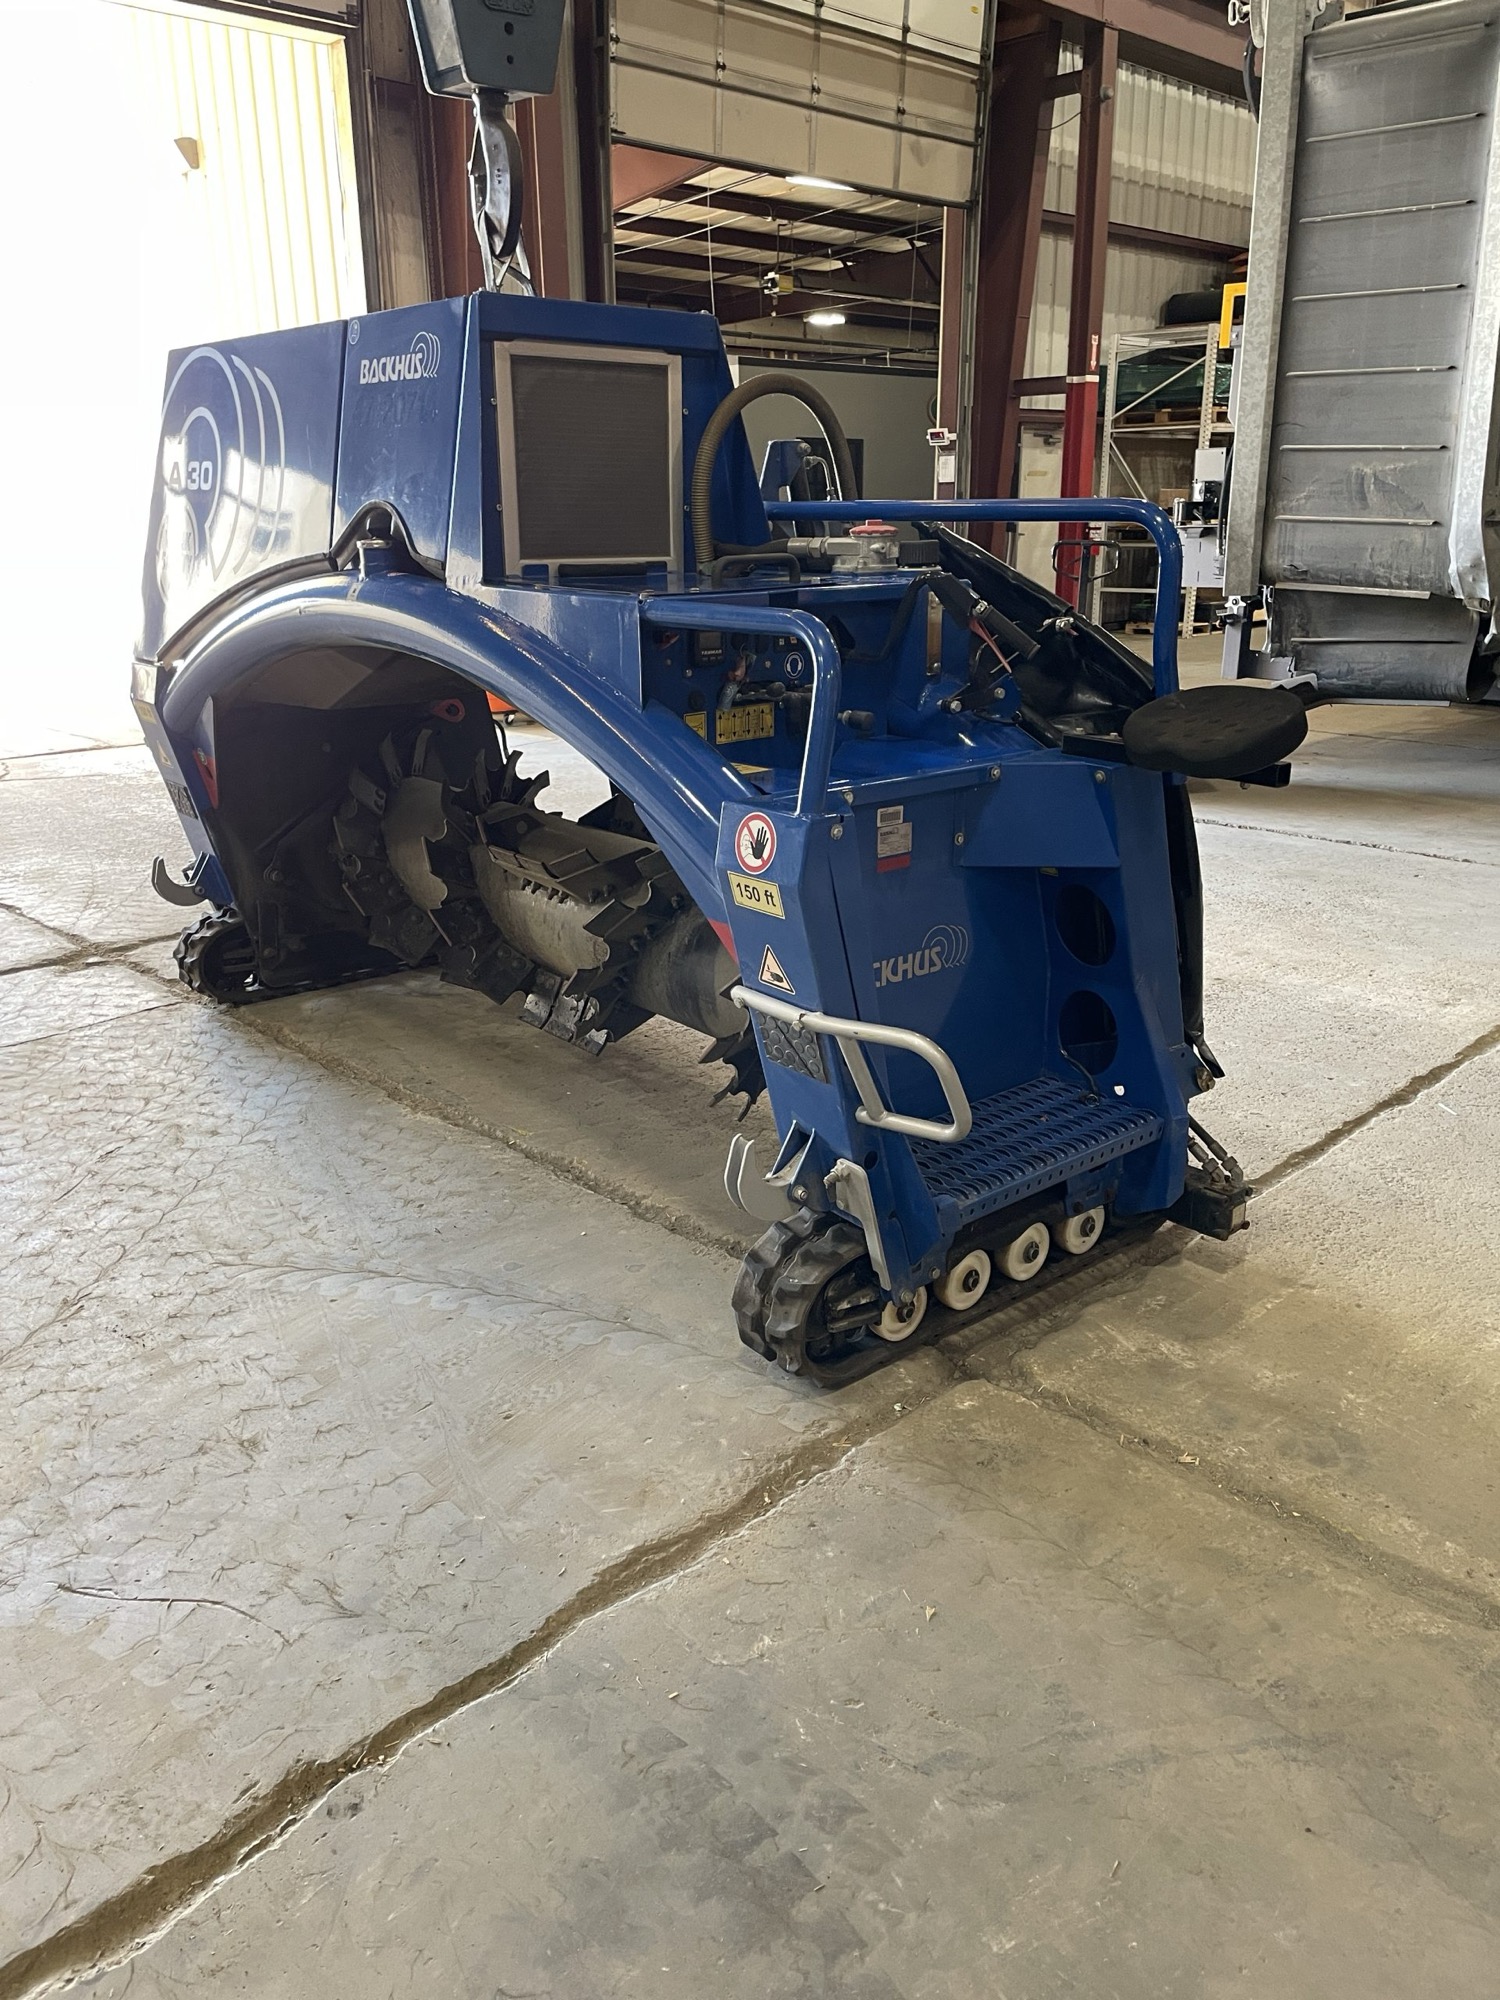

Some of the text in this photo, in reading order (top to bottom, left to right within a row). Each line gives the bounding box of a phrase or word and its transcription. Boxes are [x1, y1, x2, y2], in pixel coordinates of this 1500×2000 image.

[360, 353, 423, 385] BACKHUS
[168, 460, 213, 491] A 30
[736, 882, 777, 907] 150 ft
